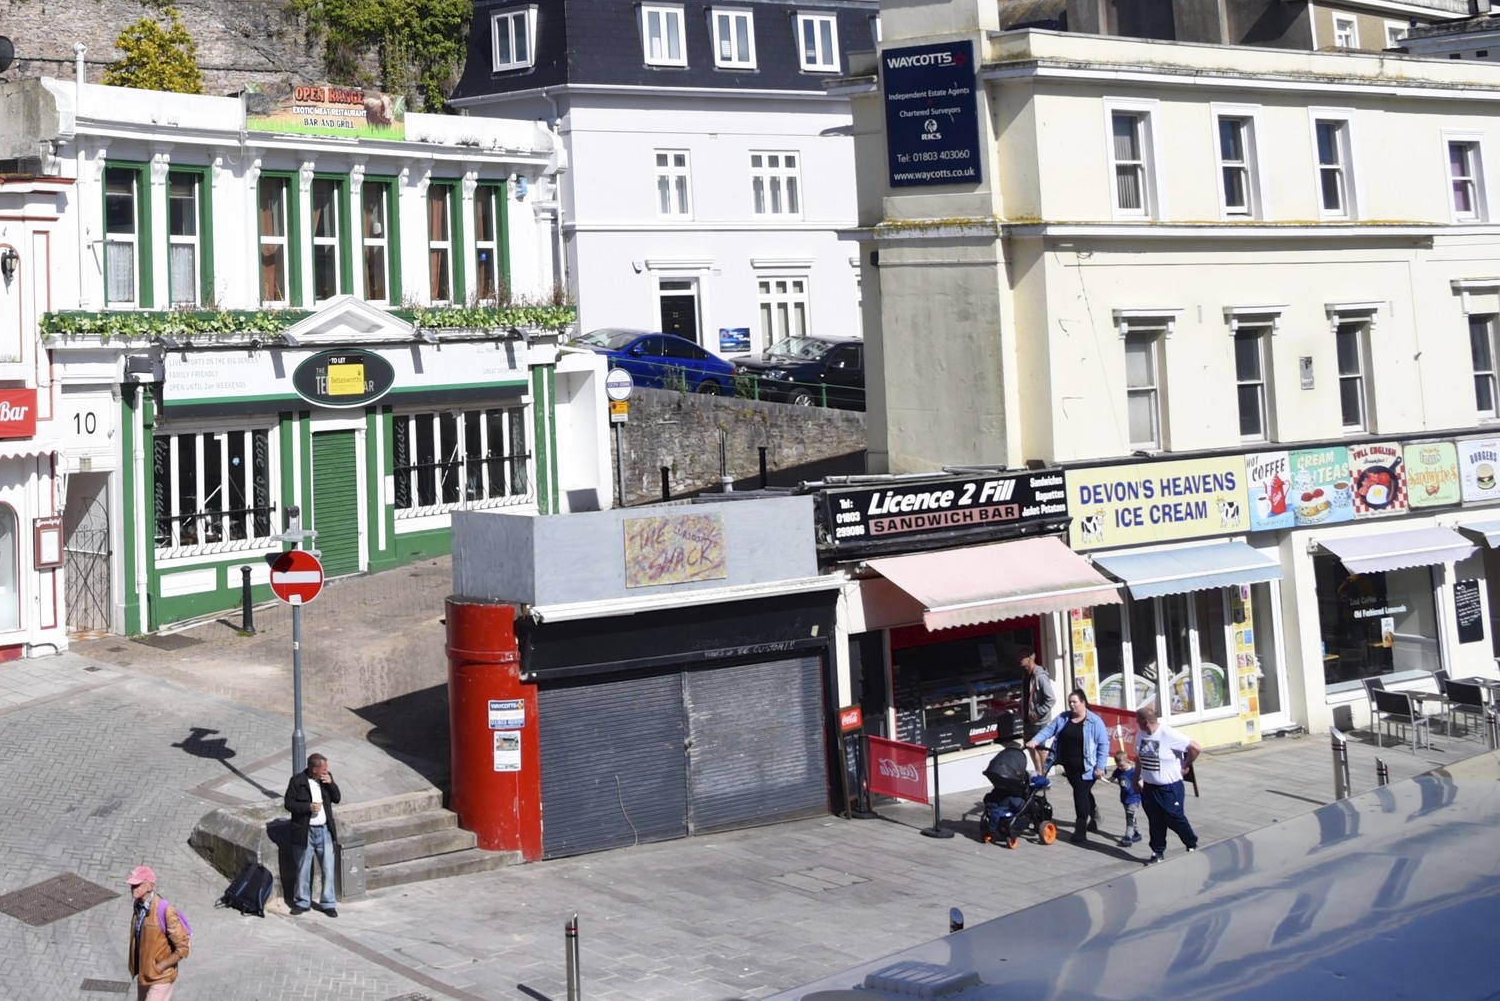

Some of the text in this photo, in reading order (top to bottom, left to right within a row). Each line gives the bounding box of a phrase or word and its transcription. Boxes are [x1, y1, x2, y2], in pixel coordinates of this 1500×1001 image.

[887, 52, 952, 69] WAYCOTTS
[295, 86, 364, 105] OPEN RANGE
[889, 87, 970, 100] Independent Estate Agents
[292, 106, 367, 118] EXOTIC MEAT RESTAURANT
[899, 107, 961, 117] Chartered Surveyors
[304, 118, 355, 129] BAR AND GRILL
[921, 132, 942, 140] RICS
[896, 149, 970, 163] Tel: 01803 403060
[894, 167, 975, 181] www.waycotts.co.uk
[73, 411, 97, 435] 10
[1297, 451, 1334, 469] CREAM
[1353, 446, 1397, 461] FULL ENGLISH
[1469, 451, 1498, 464] BURGERS
[1246, 455, 1259, 468] HOT
[1252, 458, 1285, 482] COFFEE
[1317, 462, 1349, 483] TEAS
[1030, 475, 1063, 488] Sandwiches
[1079, 471, 1236, 505] DEVON'S HEAVENS
[868, 479, 1016, 515] Licence 2 Fill
[1035, 490, 1065, 502] Baguettes
[839, 499, 854, 510] Tel:
[1022, 503, 1066, 517] Jacket Potatoes
[836, 511, 861, 523] 01803
[874, 506, 1016, 533] SANDWICH BAR
[1115, 500, 1208, 528] ICE CREAM
[835, 525, 866, 538] 299086
[969, 727, 986, 736] Licence
